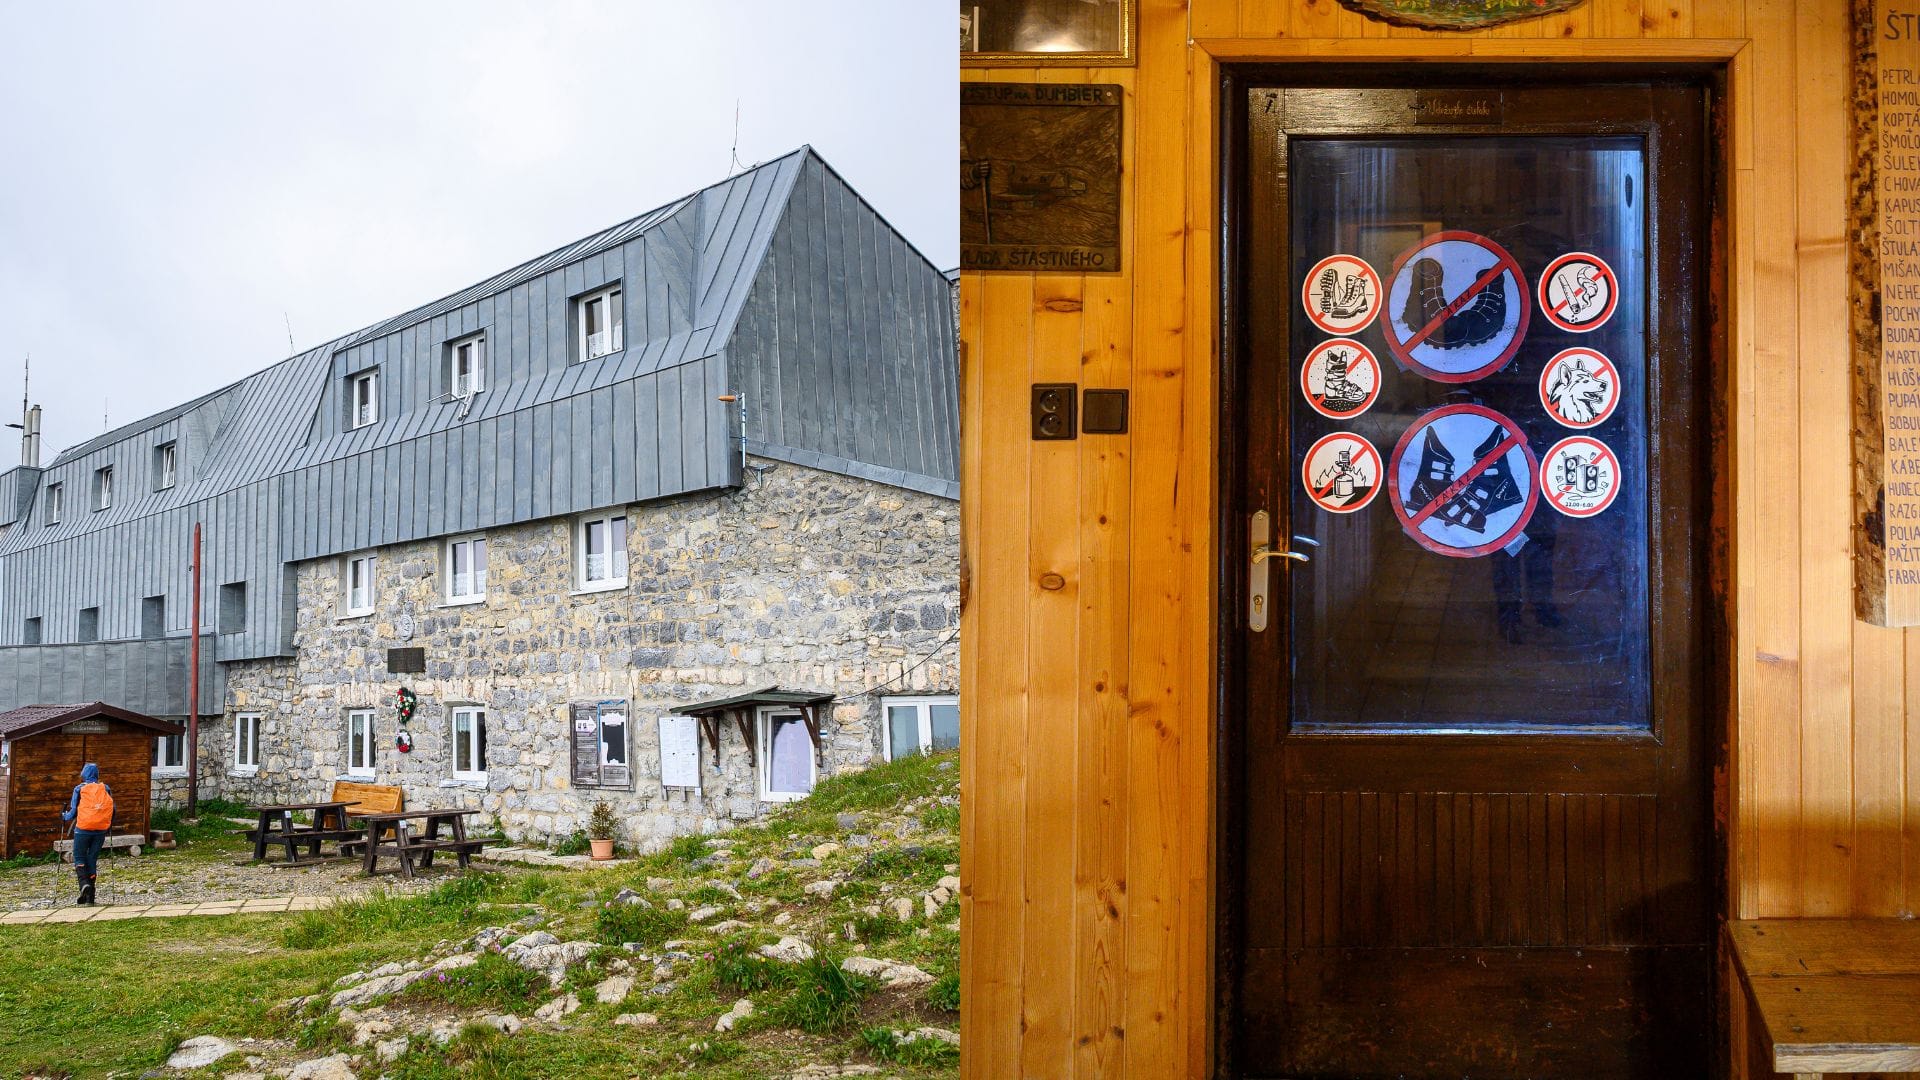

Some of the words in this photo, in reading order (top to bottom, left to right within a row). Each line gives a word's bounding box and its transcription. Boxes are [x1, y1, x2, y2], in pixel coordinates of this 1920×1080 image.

[1884, 9, 1920, 40] ŠT
[1886, 215, 1920, 234] ŠOLT
[1889, 438, 1920, 452] BALE
[1890, 503, 1920, 519] RAZG
